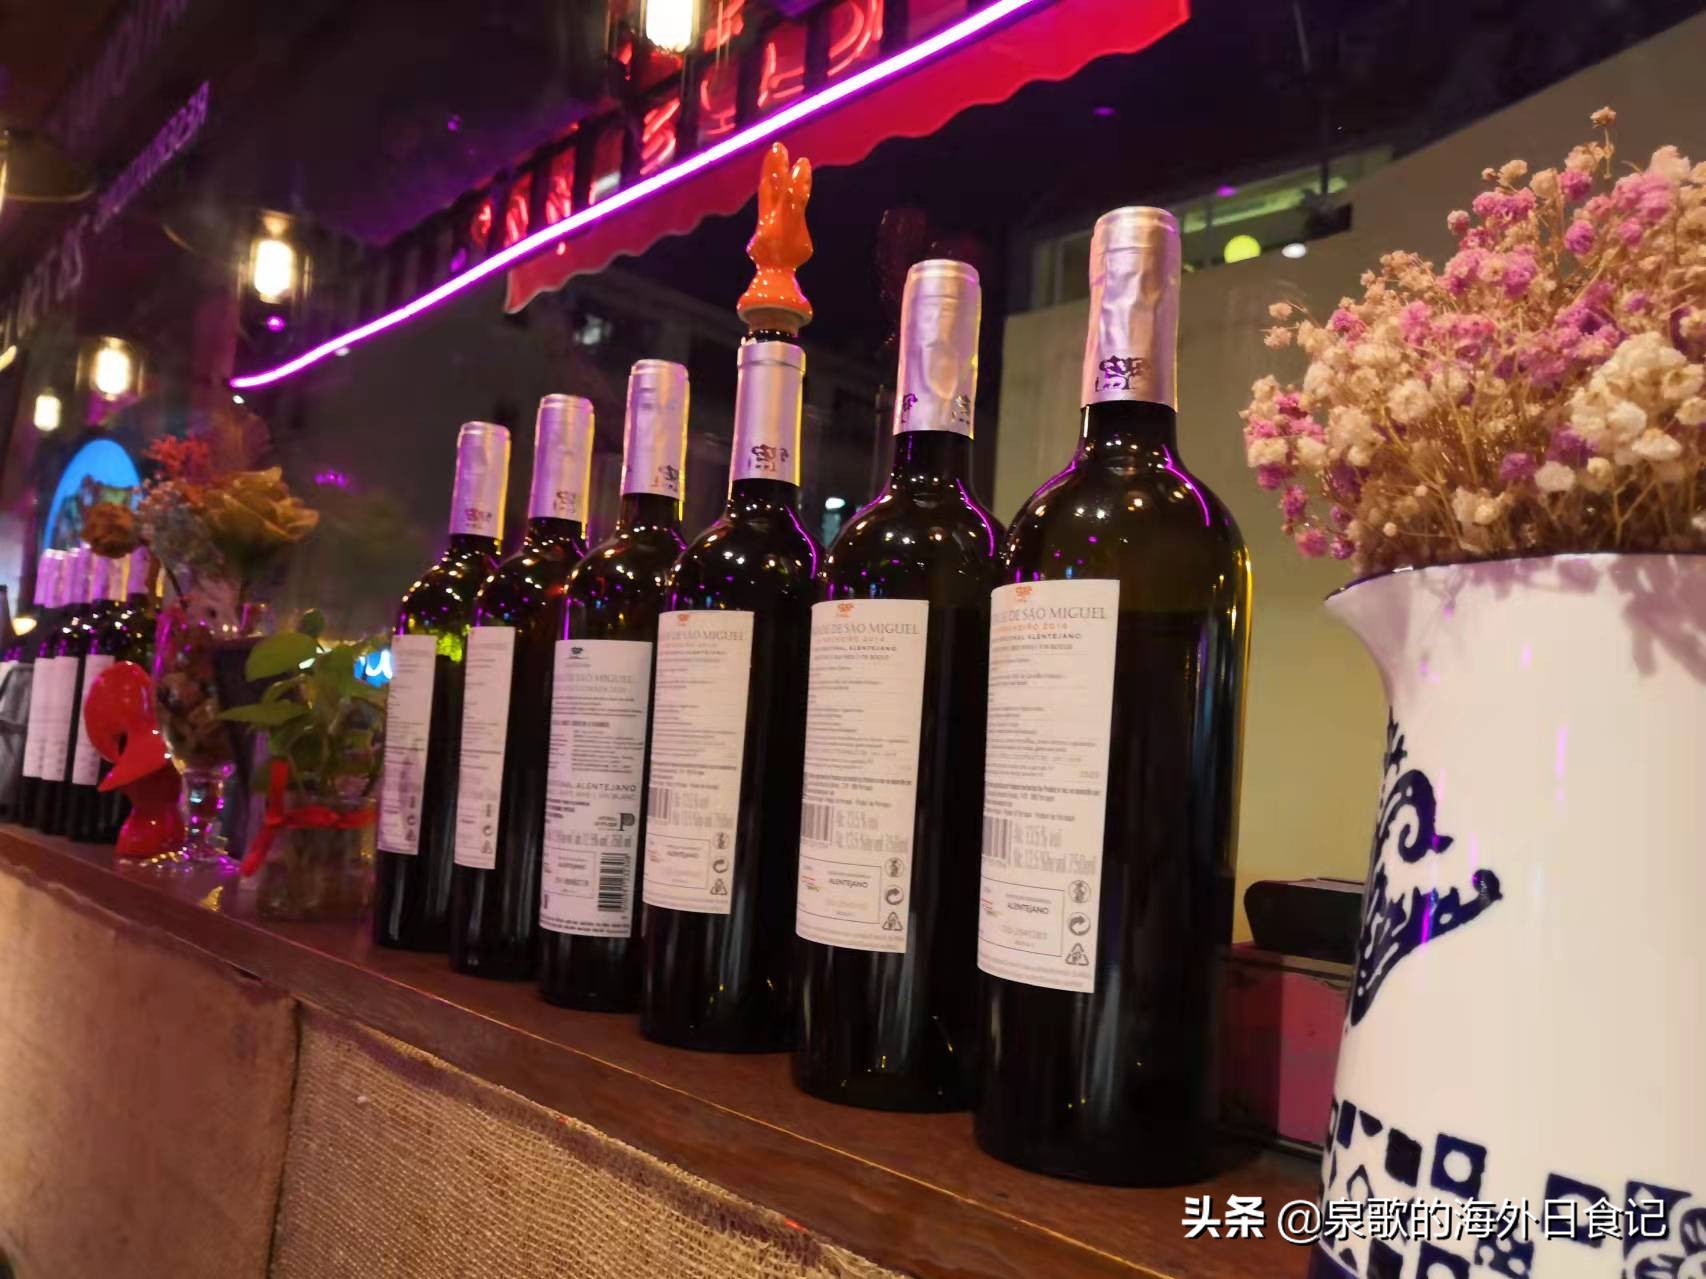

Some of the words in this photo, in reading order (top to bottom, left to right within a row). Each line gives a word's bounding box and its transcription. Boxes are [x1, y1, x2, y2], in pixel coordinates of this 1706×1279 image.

[1049, 607, 1108, 620] MIGUEL
[868, 624, 920, 635] MIGUEL
[576, 782, 637, 793] ALENTEJANO
